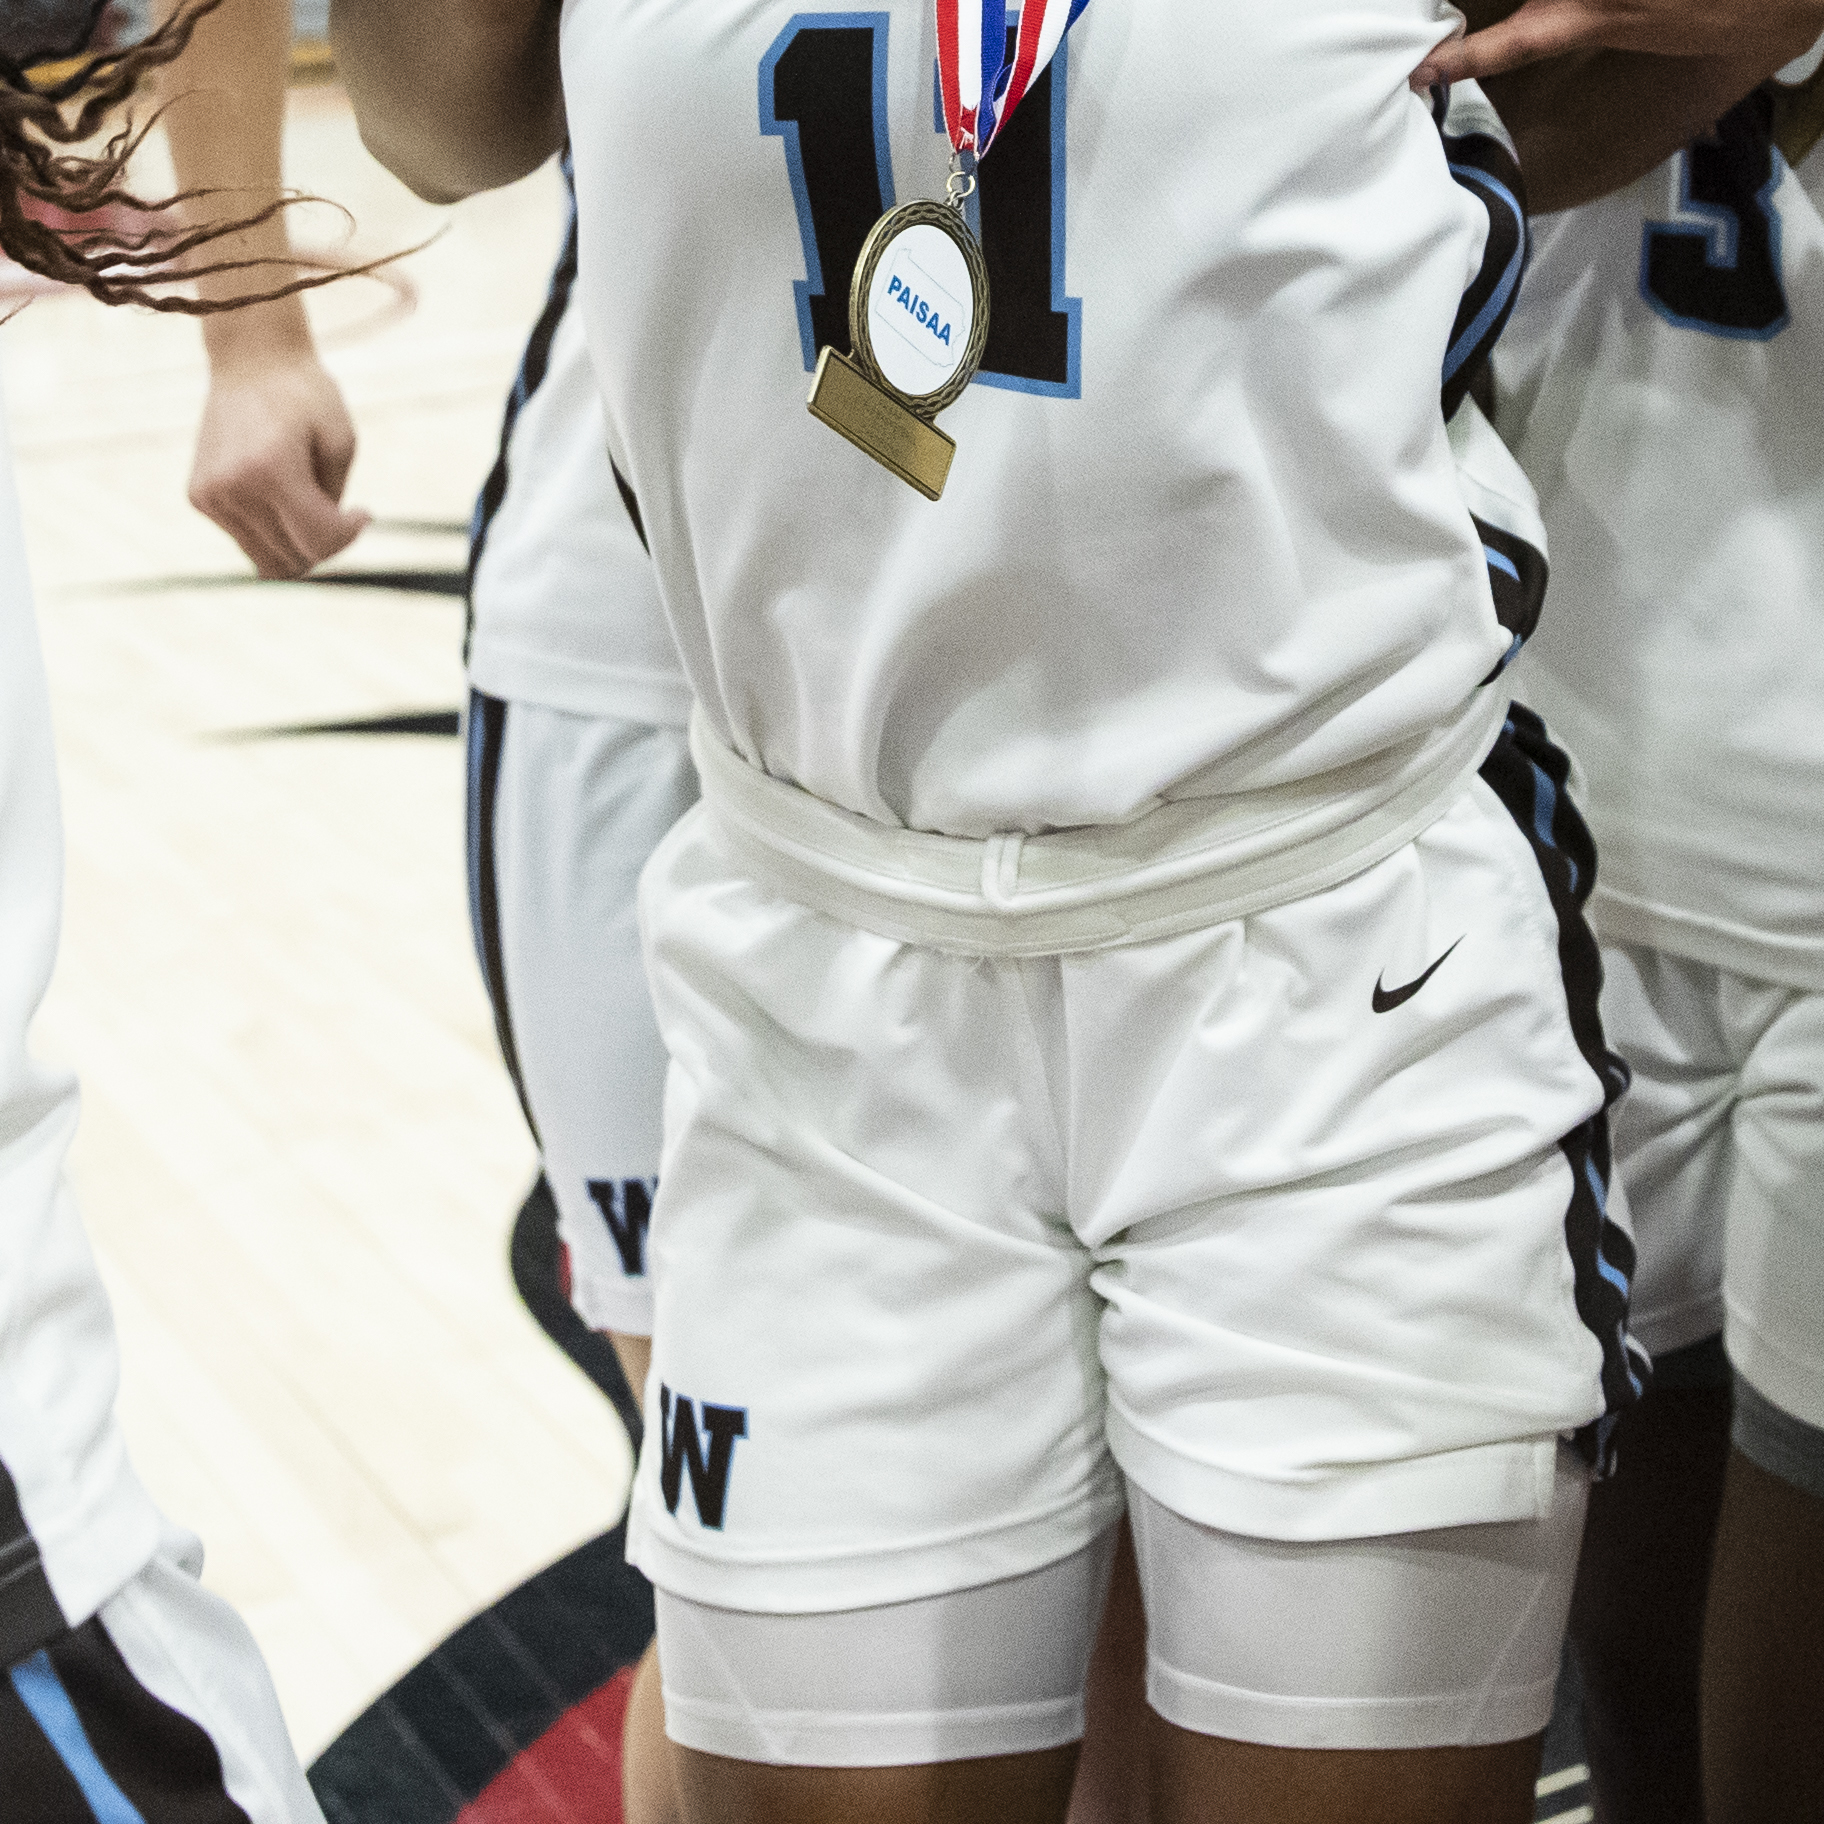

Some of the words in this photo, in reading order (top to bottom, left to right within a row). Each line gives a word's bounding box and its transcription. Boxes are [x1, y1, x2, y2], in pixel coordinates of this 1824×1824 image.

[758, 11, 1083, 400] 11
[887, 275, 952, 346] PAISAA
[660, 1381, 750, 1532] W
